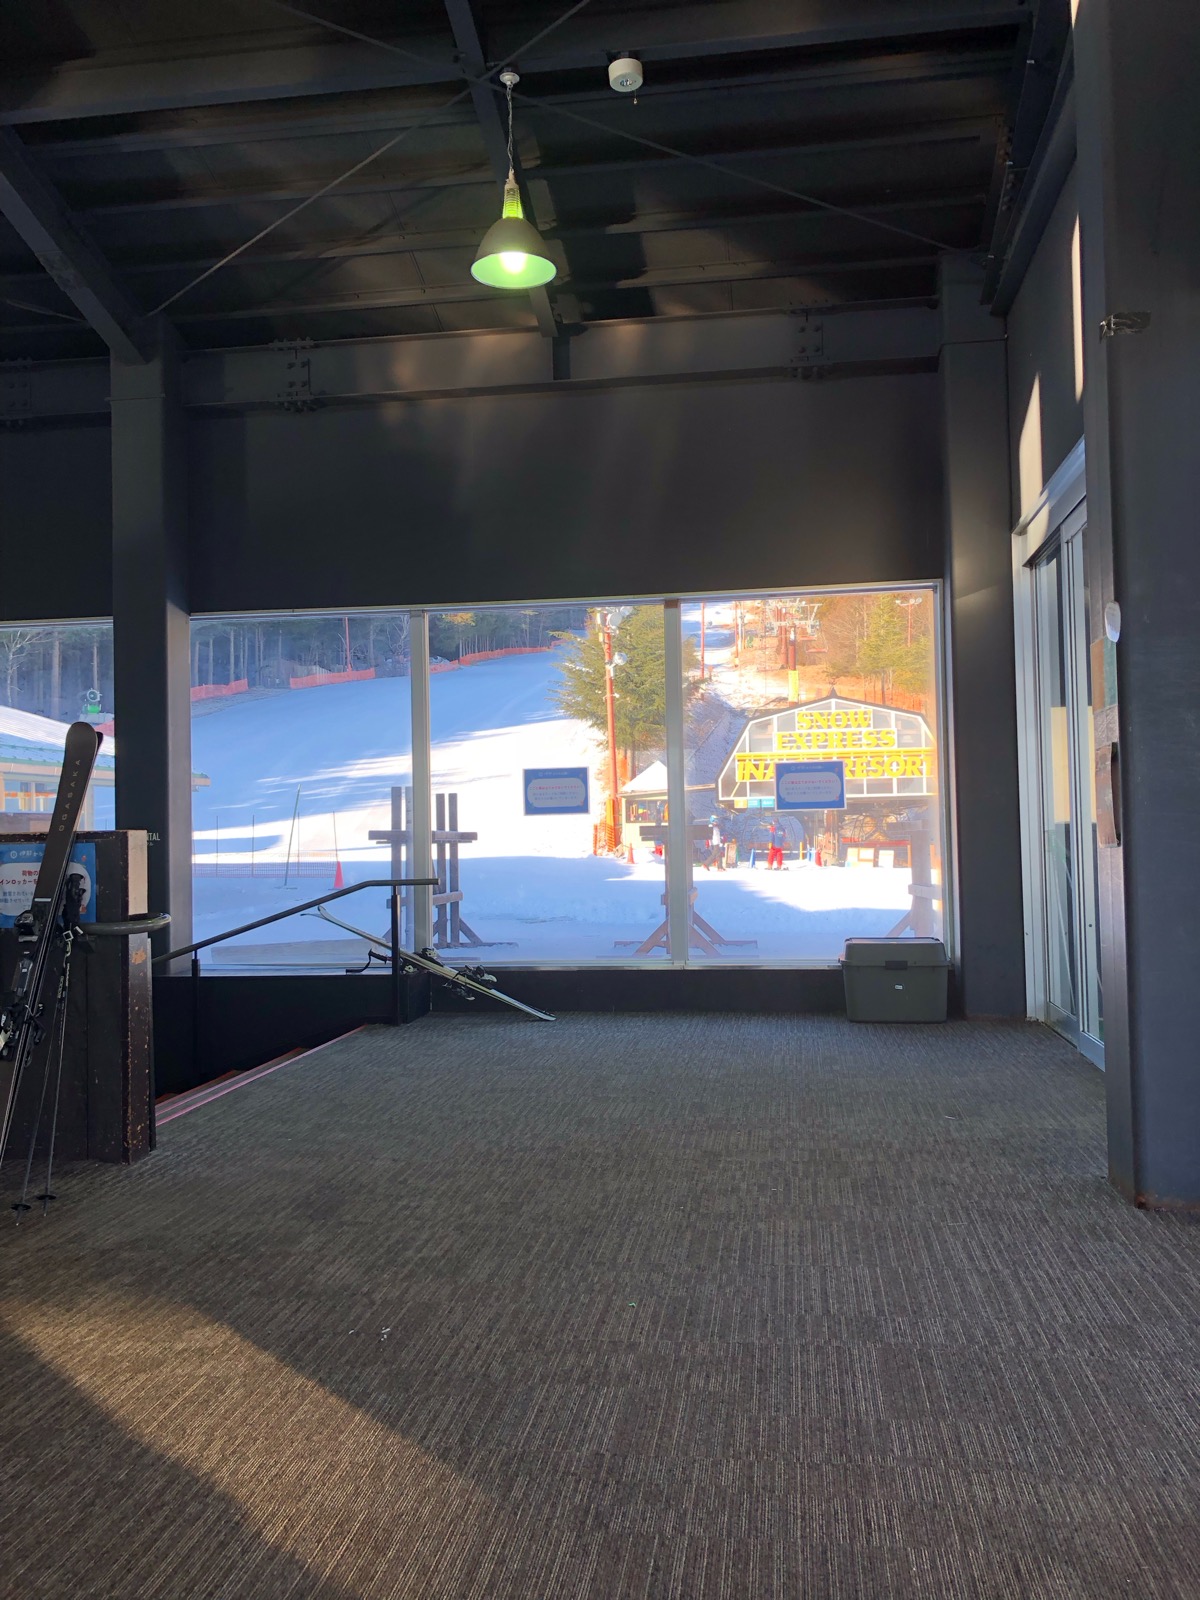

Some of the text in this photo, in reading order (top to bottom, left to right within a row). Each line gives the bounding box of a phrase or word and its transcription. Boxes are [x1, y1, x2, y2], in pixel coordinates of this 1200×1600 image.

[797, 709, 872, 730] SNOW
[776, 729, 896, 750] EXPRESS
[844, 755, 933, 778] RESORT
[58, 759, 82, 832] OGASAKA
